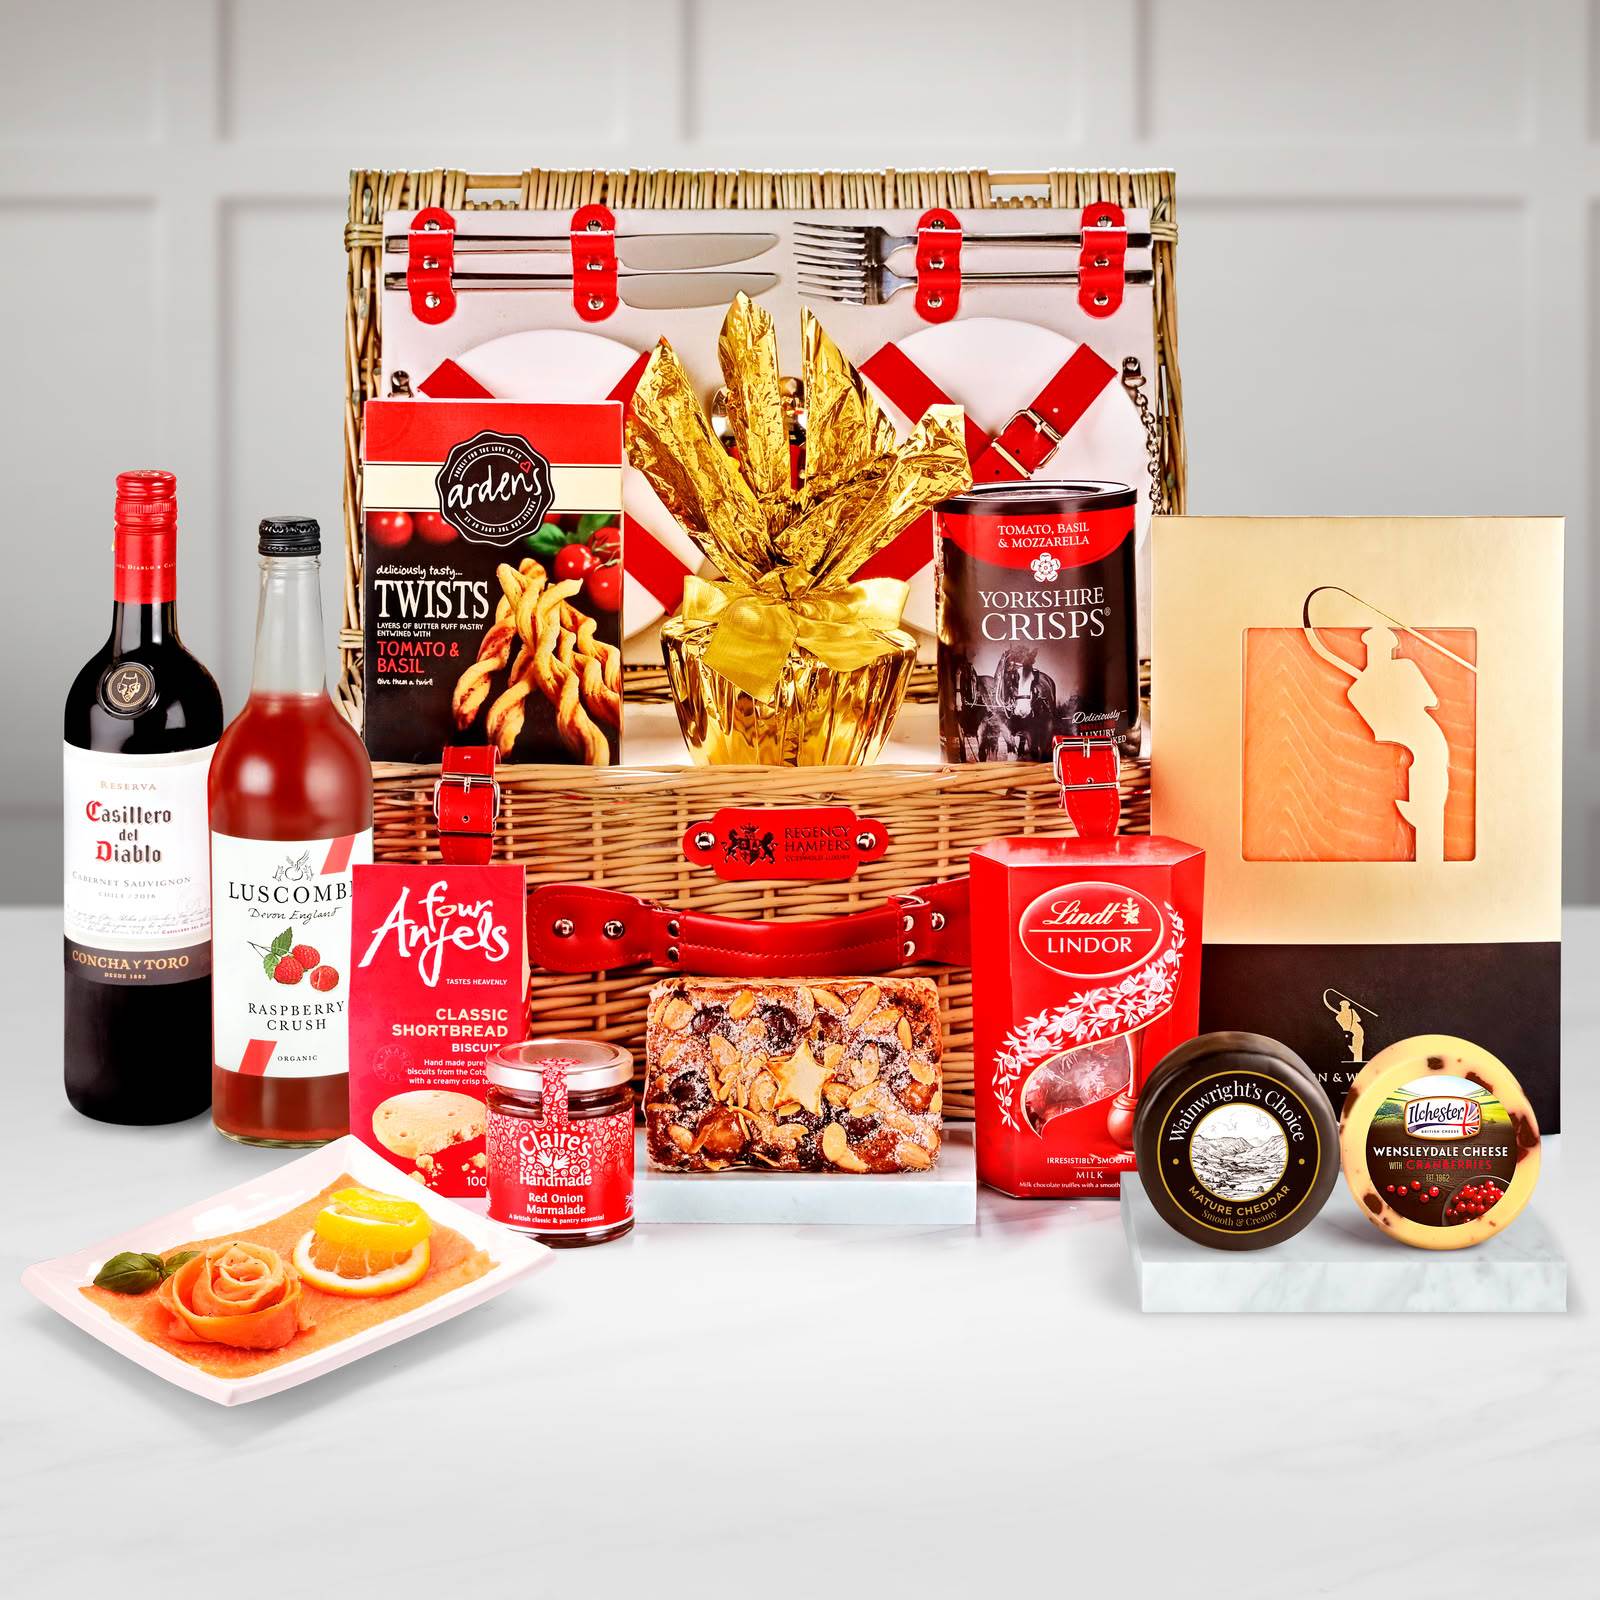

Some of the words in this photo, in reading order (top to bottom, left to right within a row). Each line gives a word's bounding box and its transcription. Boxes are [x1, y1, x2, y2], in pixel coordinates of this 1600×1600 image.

[997, 523, 1055, 536] TOMATO,
[1057, 522, 1090, 534] BASIL
[998, 538, 1009, 549] &
[1011, 535, 1090, 548] MOZZARELLA
[376, 564, 426, 580] deliciously
[374, 579, 490, 619] TWISTS
[978, 586, 1105, 609] YORKSHIRE
[413, 622, 439, 630] BUTTER
[459, 623, 484, 631] PASTRY
[376, 641, 446, 657] TOMATO
[449, 641, 460, 657] &
[377, 657, 425, 674] BASIL
[1071, 709, 1121, 724] Deliciously
[100, 780, 157, 791] RESERVA
[86, 800, 172, 824] Casillero
[119, 828, 138, 842] del
[784, 825, 850, 839] REGENCY
[96, 840, 162, 863] Diablo
[784, 839, 850, 852] HAMPERS
[72, 870, 119, 887] CABERNET
[123, 877, 191, 888] SAUVIGNON
[229, 880, 353, 904] LUSCOMB
[418, 880, 493, 933] four
[1042, 900, 1121, 925] Lindt
[247, 906, 286, 920] Devon
[288, 906, 344, 926] England
[1047, 936, 1133, 953] LINDOR
[72, 950, 130, 970] CONCHA
[133, 959, 141, 969] Y
[144, 955, 189, 970] TORO
[472, 978, 508, 986] HEAVENLY
[248, 1000, 345, 1017] RASPBERRY
[435, 1008, 508, 1021] CLASSIC
[266, 1018, 327, 1031] CRUSH
[391, 1023, 508, 1038] SHORTBREAD
[277, 1054, 318, 1062] ORGANIC
[423, 1059, 443, 1067] Hand
[445, 1059, 466, 1067] made
[407, 1067, 435, 1076] biscuits
[437, 1067, 454, 1076] from
[455, 1067, 469, 1076] the
[1332, 1072, 1343, 1083] &
[461, 1078, 480, 1086] crisp
[1168, 1080, 1263, 1142] Wainwright's
[1264, 1090, 1305, 1143] Choice
[1407, 1101, 1465, 1125] Ilchester
[519, 1128, 592, 1156] Claire's
[1373, 1146, 1458, 1157] WENSLEYDALE
[1462, 1146, 1508, 1157] CHEESE
[1389, 1161, 1403, 1170] WITH
[1406, 1159, 1493, 1171] CRANBERRIES
[519, 1170, 592, 1187] Handmade
[1075, 1171, 1104, 1179] MILK
[528, 1192, 548, 1203] Red
[551, 1192, 584, 1203] Onion
[1188, 1185, 1233, 1216] MATURE
[1236, 1184, 1291, 1216] CHEDDAR
[526, 1204, 586, 1215] Marmalade
[532, 1216, 551, 1224] classic
[559, 1217, 579, 1225] pantry
[580, 1214, 605, 1222] essential
[1201, 1209, 1234, 1227] Smooth
[1244, 1209, 1278, 1227] Creamy
